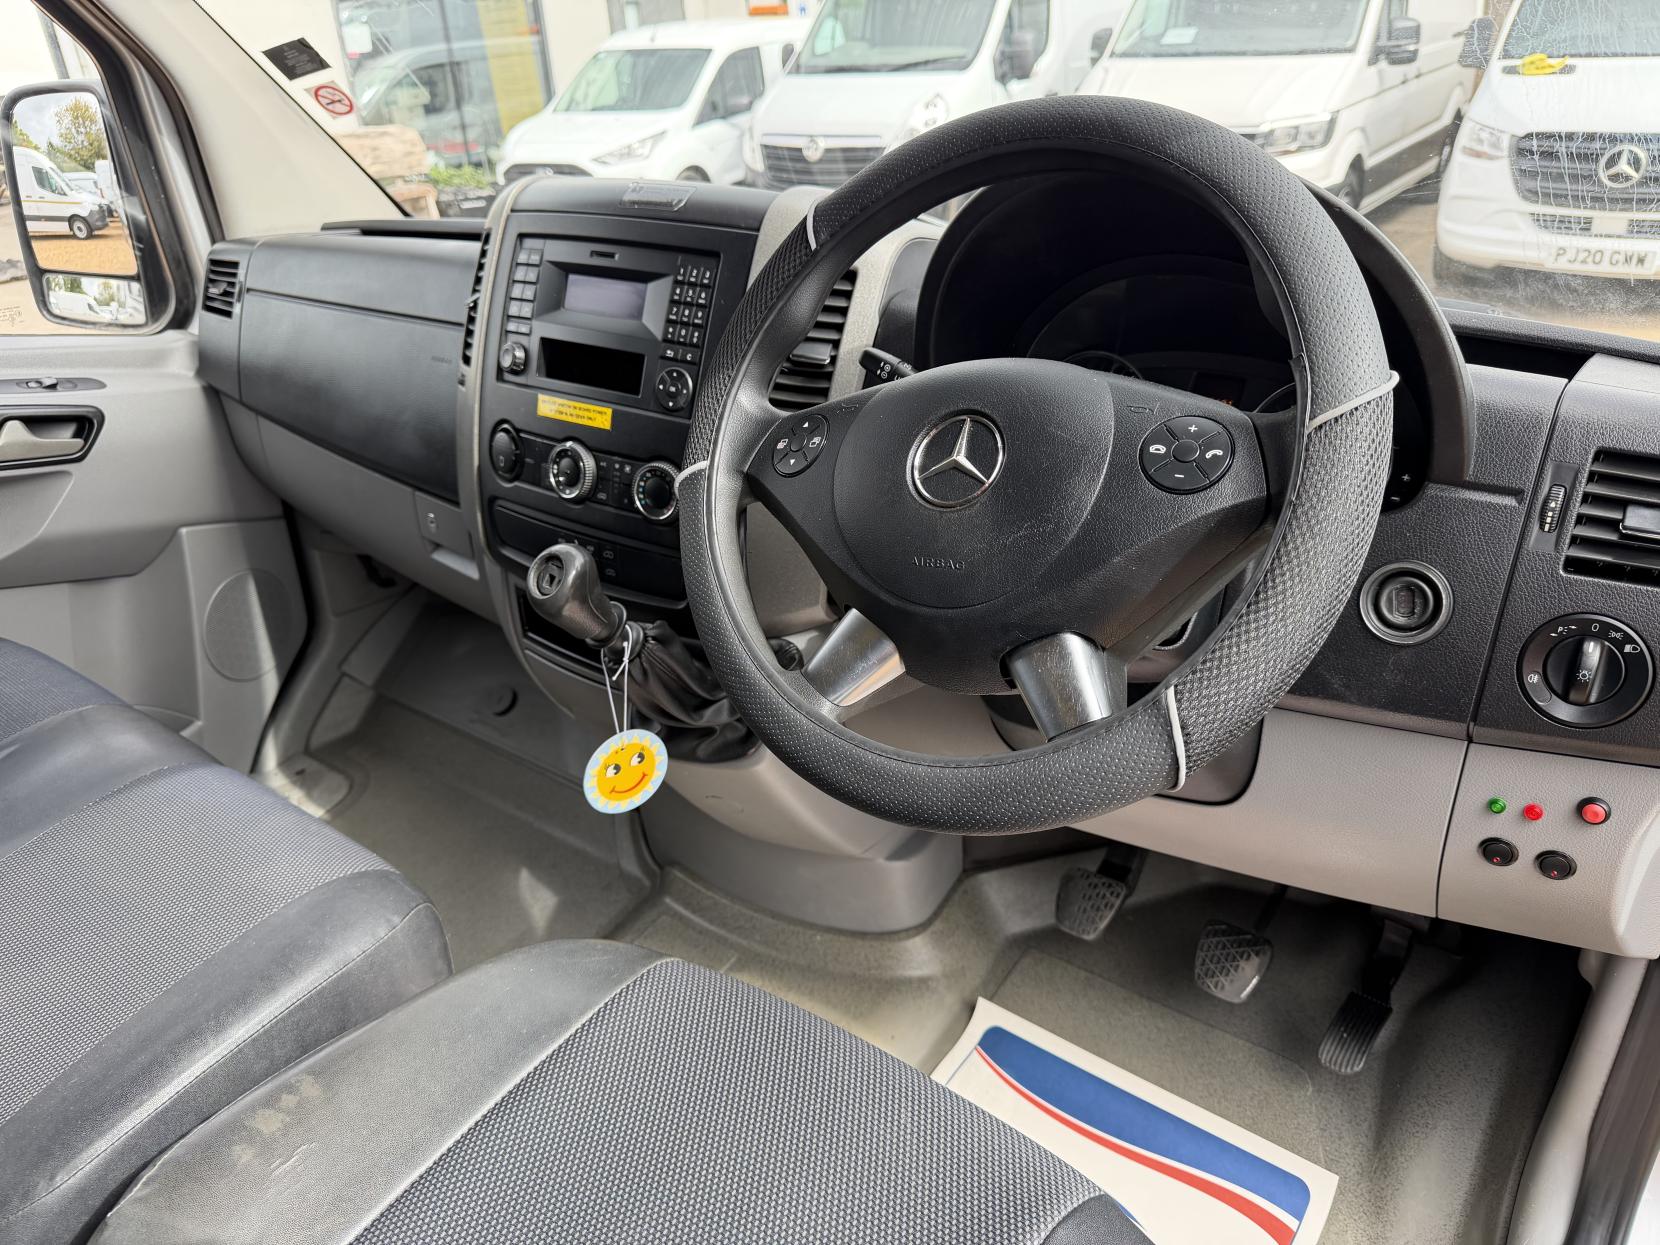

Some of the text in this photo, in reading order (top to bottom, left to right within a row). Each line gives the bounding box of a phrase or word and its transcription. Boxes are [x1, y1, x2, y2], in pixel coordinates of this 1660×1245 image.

[1554, 247, 1604, 265] PJ20
[686, 353, 692, 361] C
[912, 556, 965, 570] AIRBAG
